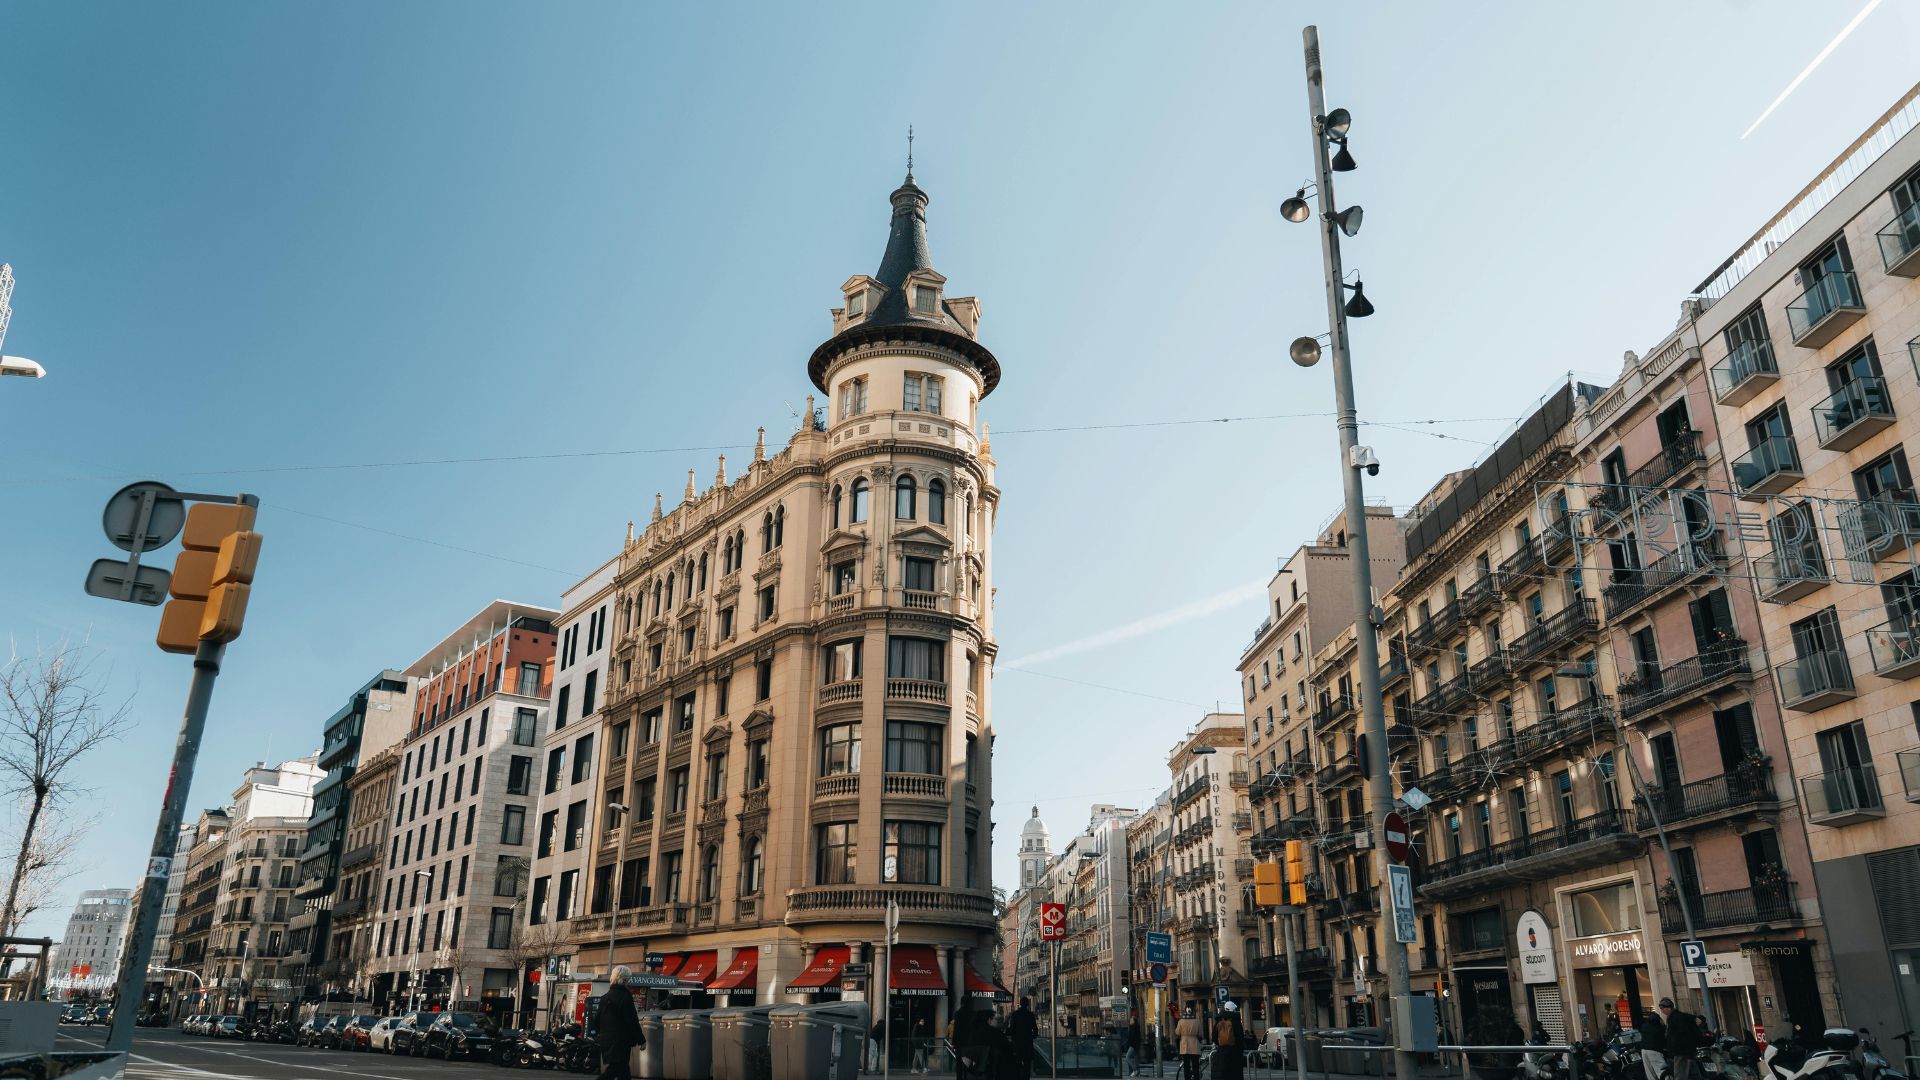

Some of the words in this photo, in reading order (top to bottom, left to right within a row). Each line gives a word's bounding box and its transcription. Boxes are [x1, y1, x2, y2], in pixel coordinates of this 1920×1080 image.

[1211, 772, 1222, 828] HOTEL
[1215, 847, 1227, 928] MIDMOST
[1049, 911, 1059, 920] M
[1575, 943, 1604, 956] ALVARO
[1605, 938, 1641, 953] MORENO
[1760, 945, 1799, 956] lemon
[1153, 951, 1165, 959] taxi
[1525, 954, 1547, 965] stucom
[1685, 944, 1701, 965] P
[549, 958, 556, 973] P
[1708, 962, 1732, 971] ORENCIA
[1218, 988, 1228, 1000] P
